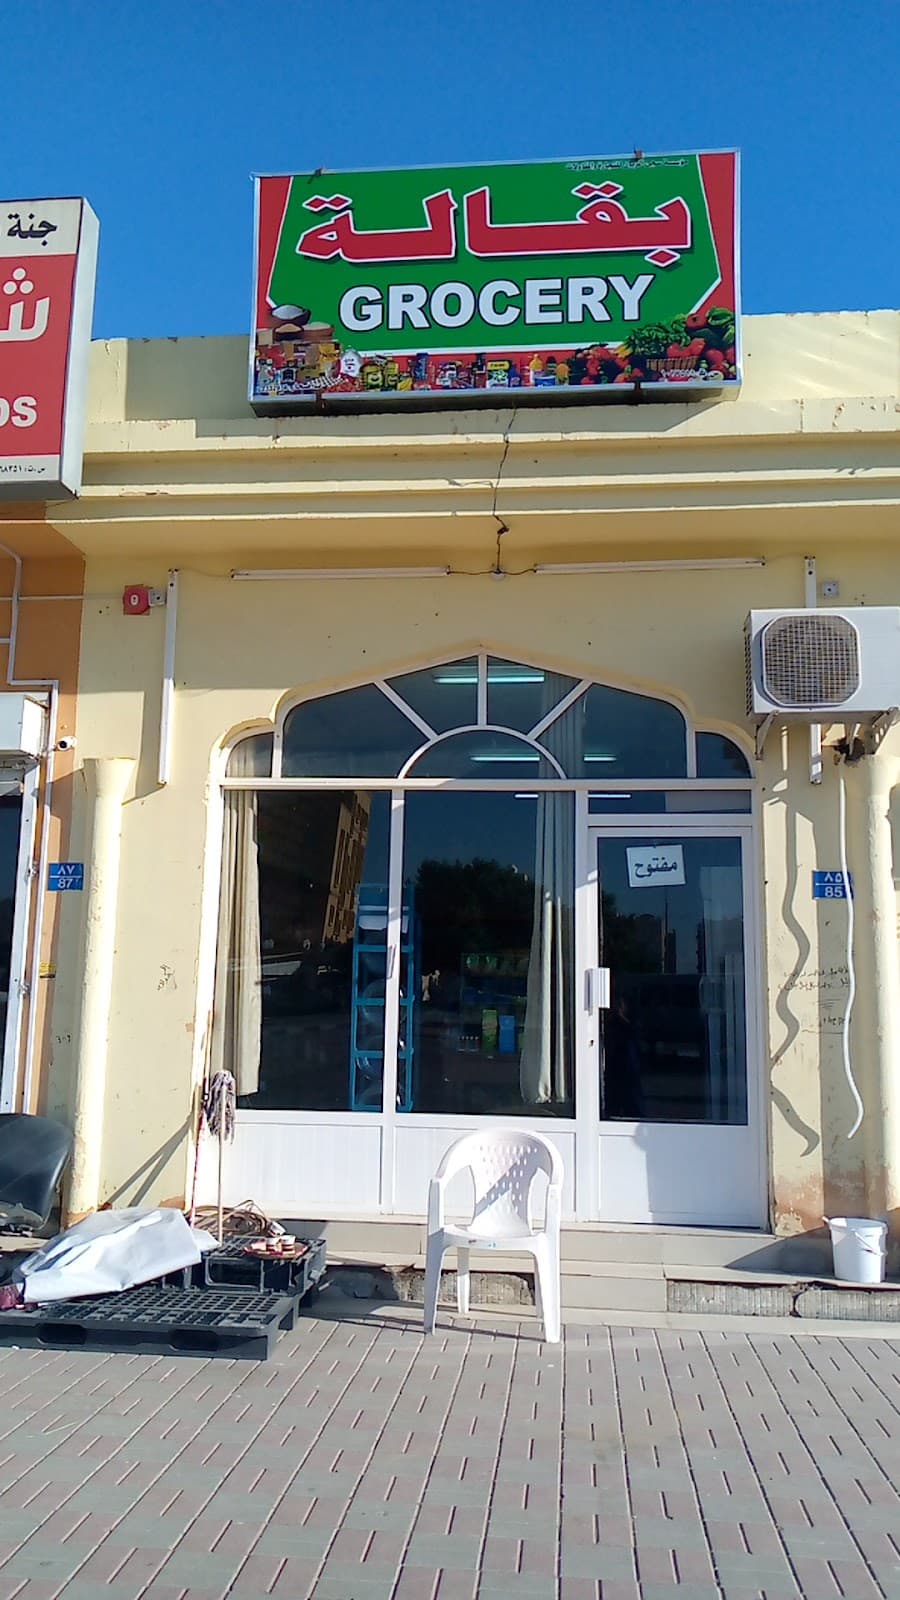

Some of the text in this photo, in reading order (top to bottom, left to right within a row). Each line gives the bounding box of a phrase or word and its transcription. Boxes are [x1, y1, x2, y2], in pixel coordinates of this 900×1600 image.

[7, 212, 58, 247] جنة
[295, 180, 693, 269] بقالة
[338, 274, 656, 332] GROCERY
[57, 864, 76, 875] ٨٧
[634, 857, 678, 878] مفتوح
[57, 878, 74, 889] 87
[824, 872, 843, 883] ٨٥
[824, 886, 844, 898] 85
